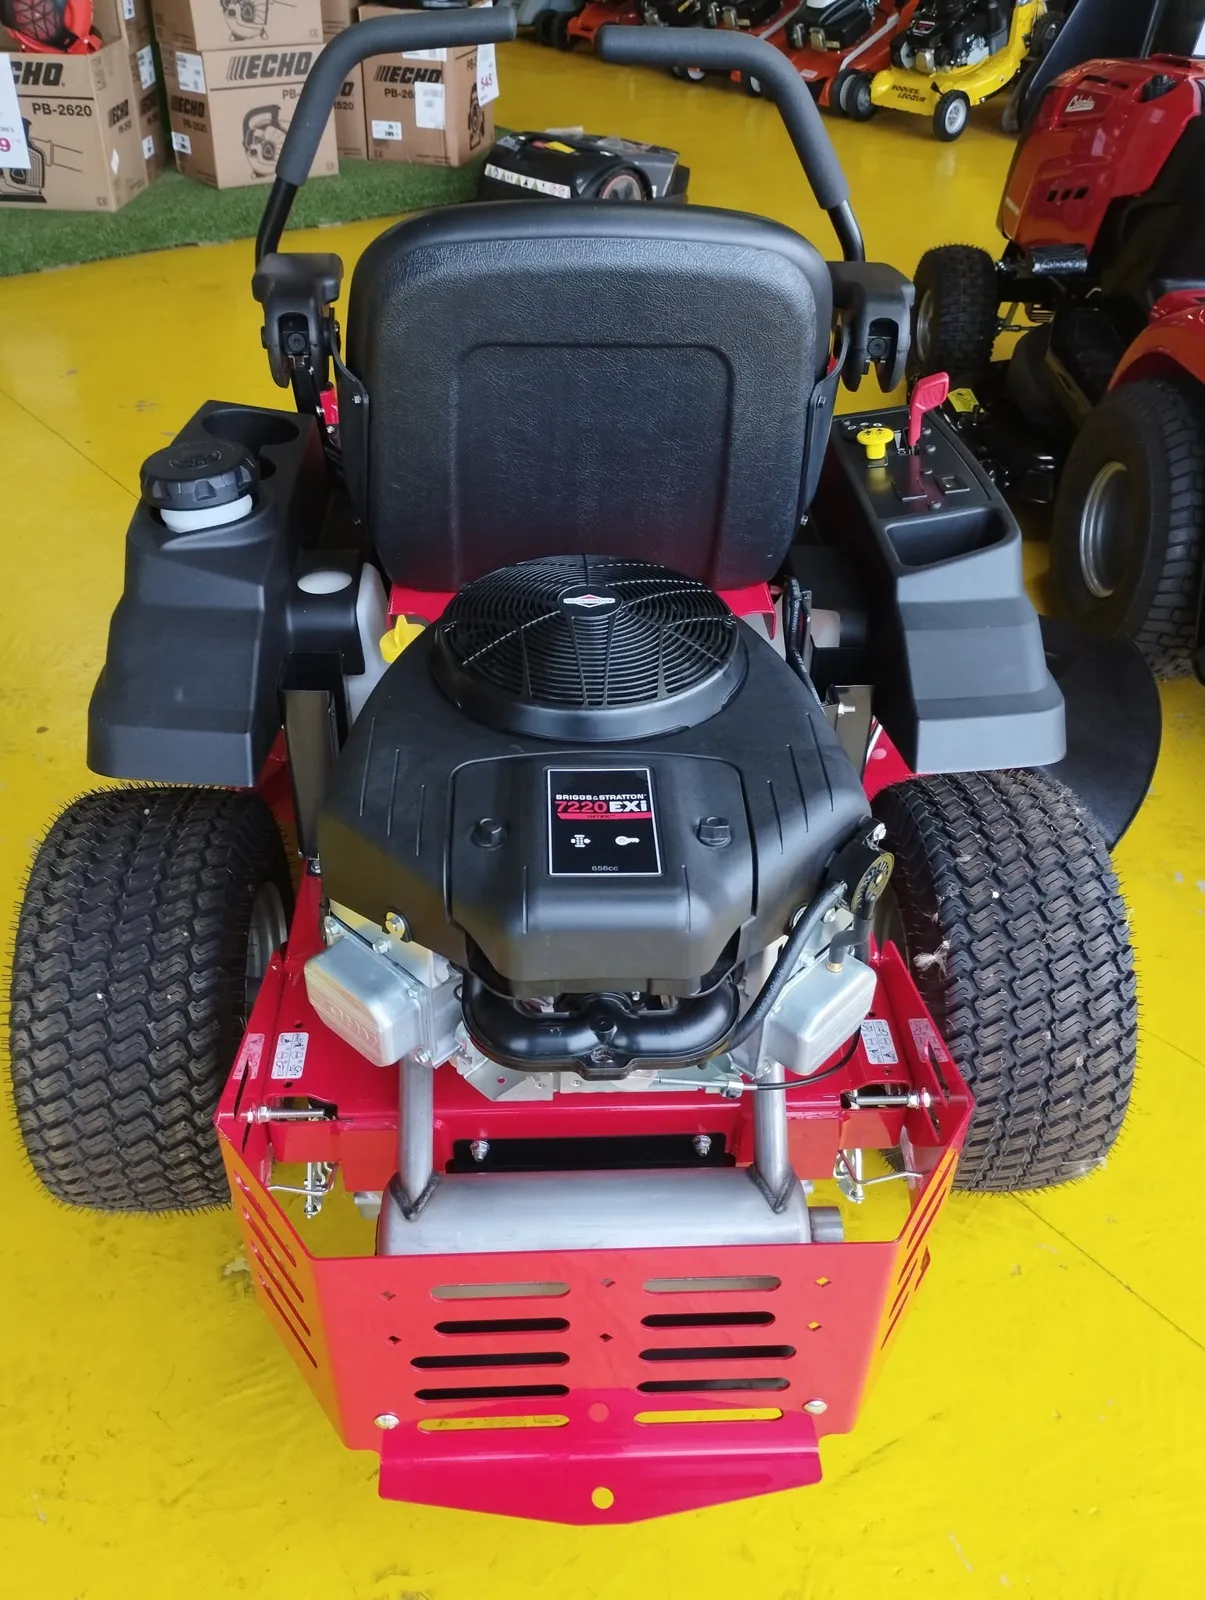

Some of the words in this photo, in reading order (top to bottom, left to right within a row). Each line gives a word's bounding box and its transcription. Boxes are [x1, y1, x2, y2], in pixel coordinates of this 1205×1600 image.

[10, 61, 64, 87] CHO
[245, 51, 313, 80] ECHO
[388, 66, 443, 85] ECHO
[384, 87, 415, 99] PB-26
[31, 102, 92, 117] PB-2620
[179, 96, 205, 118] ECHO
